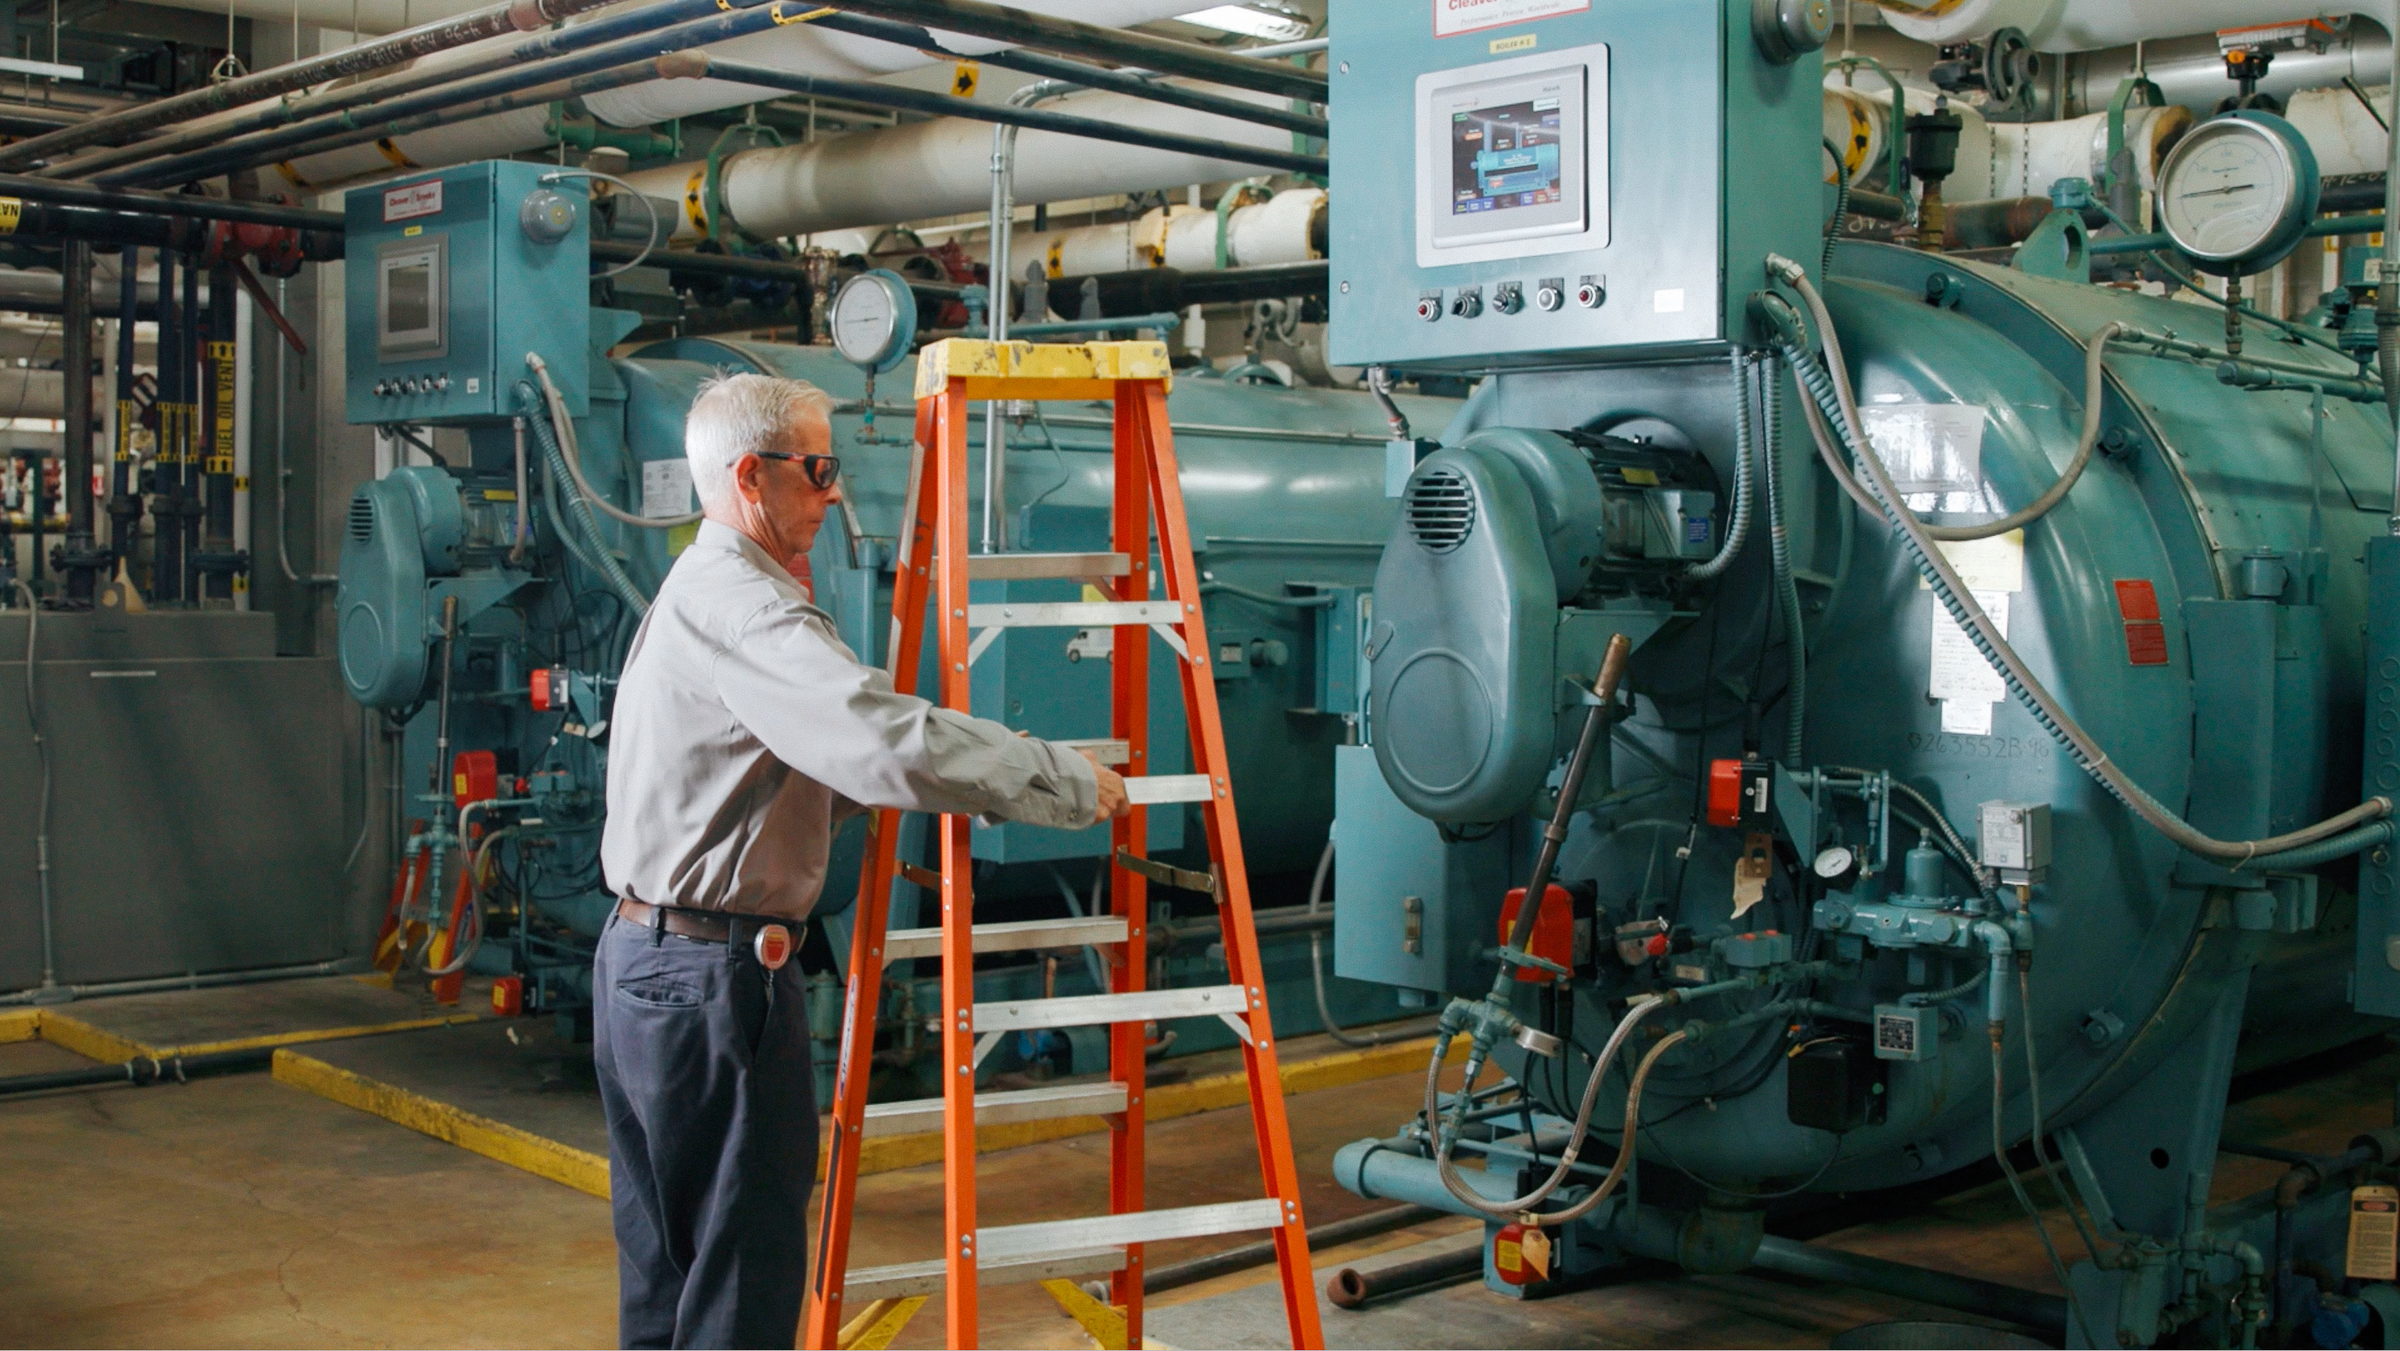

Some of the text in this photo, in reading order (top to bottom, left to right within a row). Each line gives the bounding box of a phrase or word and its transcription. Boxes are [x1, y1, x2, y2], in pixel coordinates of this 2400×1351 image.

[218, 360, 234, 456] FUEL OIL VENT
